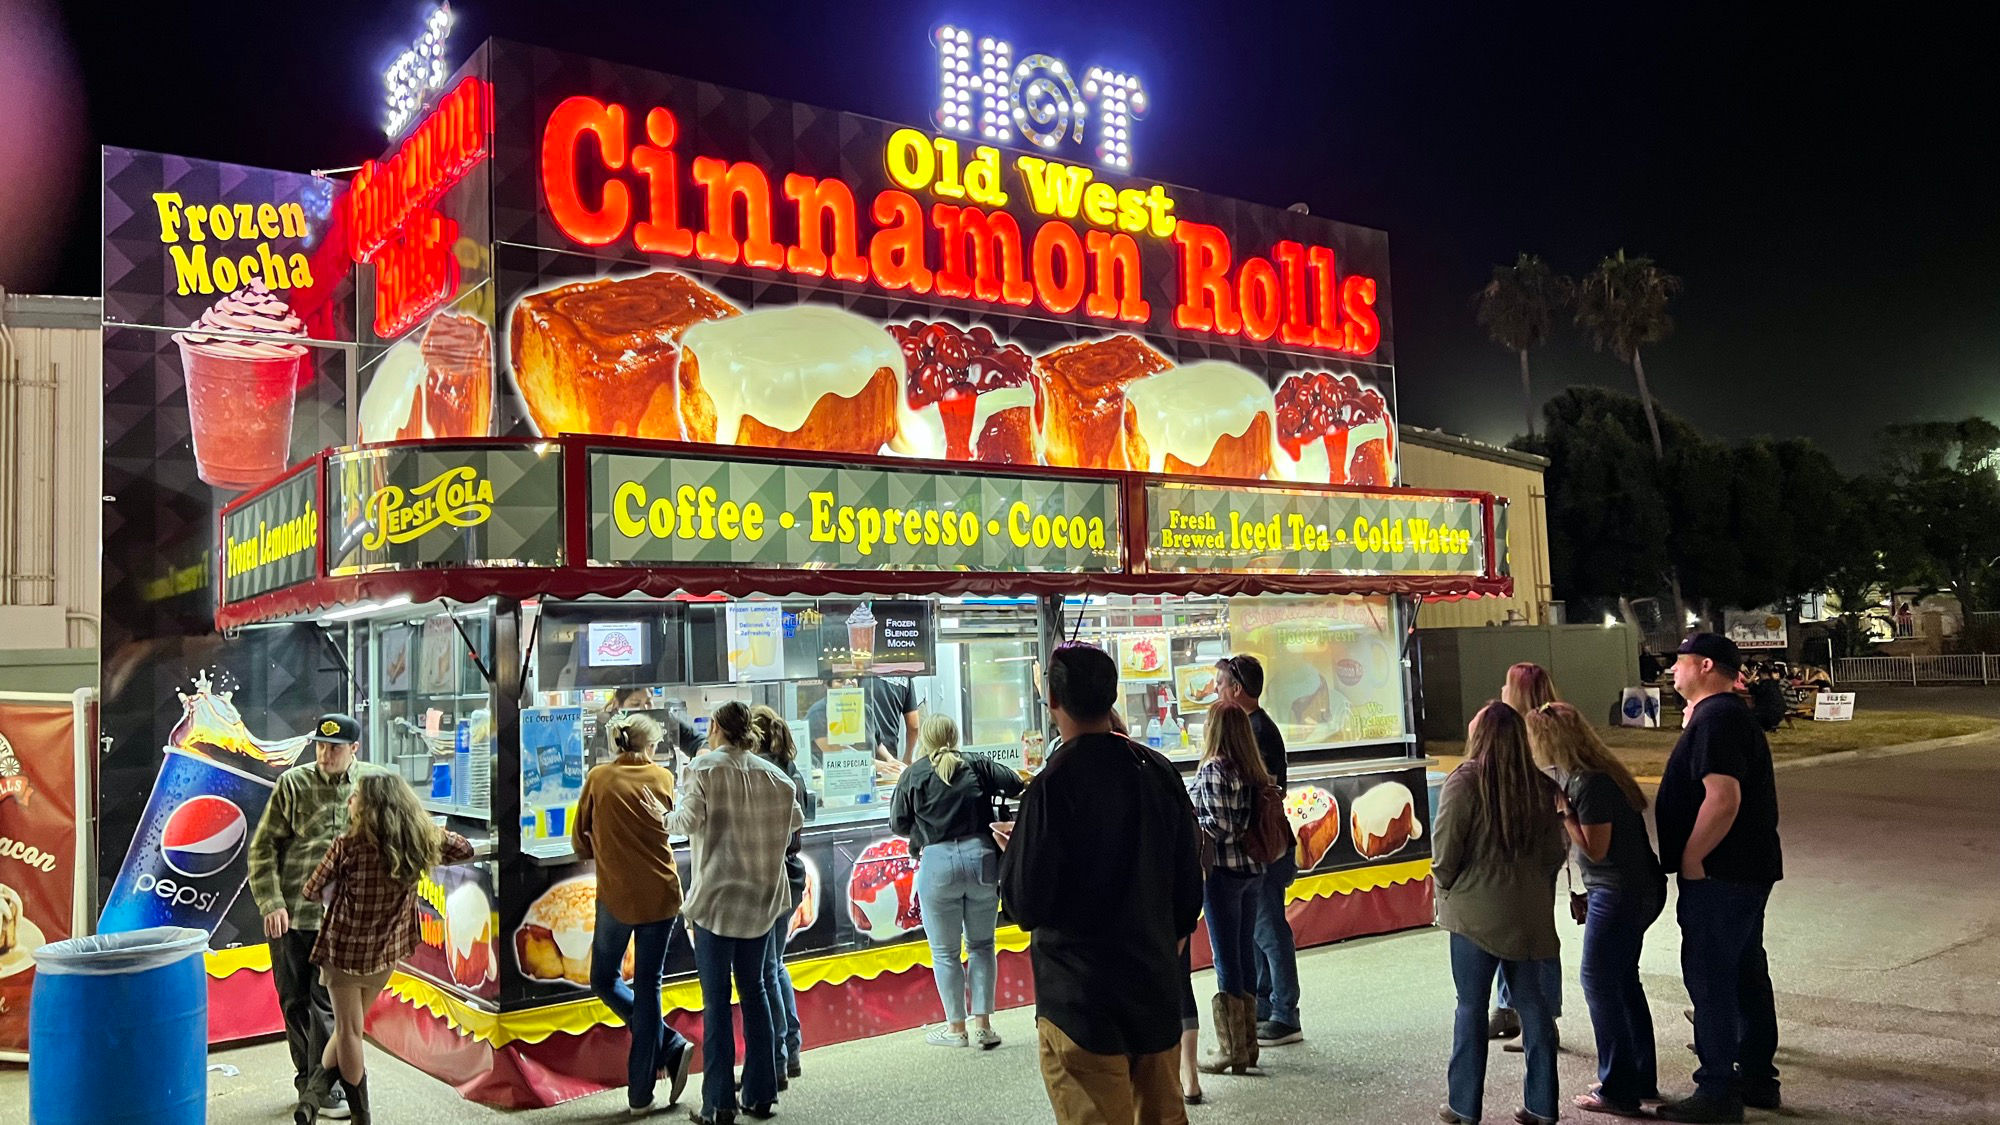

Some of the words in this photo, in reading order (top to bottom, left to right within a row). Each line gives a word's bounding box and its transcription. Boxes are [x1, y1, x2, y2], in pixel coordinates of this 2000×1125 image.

[932, 25, 1146, 170] HOT
[885, 128, 1009, 207] Old
[1015, 155, 1177, 238] West
[152, 192, 309, 243] Frozen
[542, 95, 1152, 324] Cinnamon
[168, 242, 315, 296] Mocha
[1174, 219, 1381, 356] Rolls
[227, 535, 259, 579] Frozen
[259, 500, 317, 565] Lemonade
[612, 480, 764, 542] Coffee
[808, 491, 980, 556] Espresso
[1007, 501, 1106, 550] Cocoa
[1161, 528, 1225, 549] Brewed
[1169, 510, 1217, 530] Fresh
[1229, 511, 1281, 551] Iced
[1287, 513, 1330, 552] Tea
[1353, 516, 1404, 554] Cold
[1407, 518, 1470, 556] Water
[884, 628, 919, 638] BLENDED
[885, 618, 916, 628] FROZEN
[887, 638, 916, 648] MOCHA
[826, 760, 842, 769] FAIR
[843, 759, 869, 768] SPECIAL
[987, 748, 1020, 760] SPECIAL
[132, 873, 220, 913] pepsi
